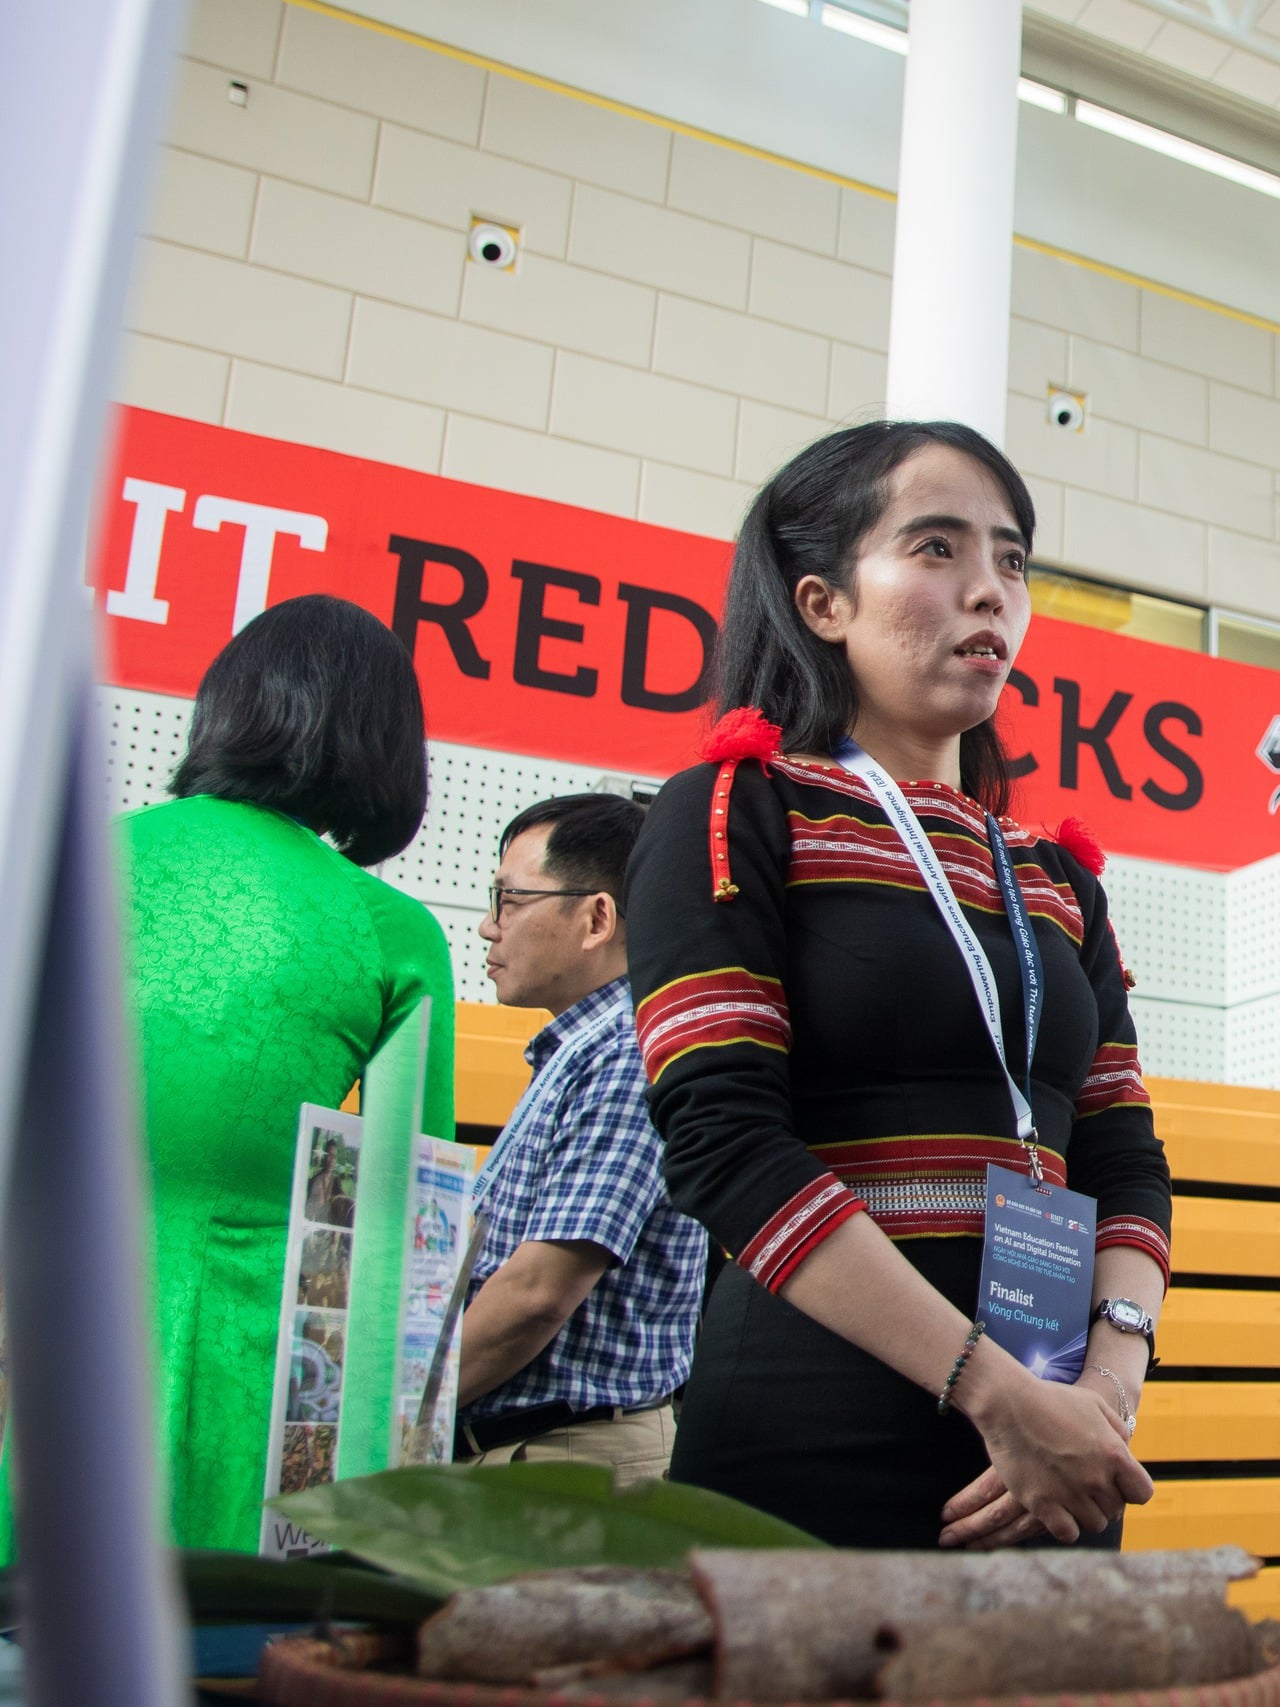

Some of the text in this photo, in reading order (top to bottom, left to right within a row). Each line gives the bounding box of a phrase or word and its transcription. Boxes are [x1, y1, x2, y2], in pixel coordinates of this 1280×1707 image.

[84, 476, 328, 640] IT
[885, 791, 918, 840] Intelligence
[913, 842, 941, 880] Artificial
[935, 882, 950, 904] with
[947, 905, 975, 952] Educators
[1012, 903, 1024, 928] trong
[973, 954, 996, 1023] Empowering
[511, 1102, 533, 1134] Educators
[531, 1088, 542, 1106] with
[994, 1222, 1079, 1257] Vietnam Education Festival
[994, 1235, 1082, 1268] on AI and Digital Innovation
[990, 1280, 1034, 1307] Finalist
[988, 1301, 1060, 1331] Vòng Chung kết
